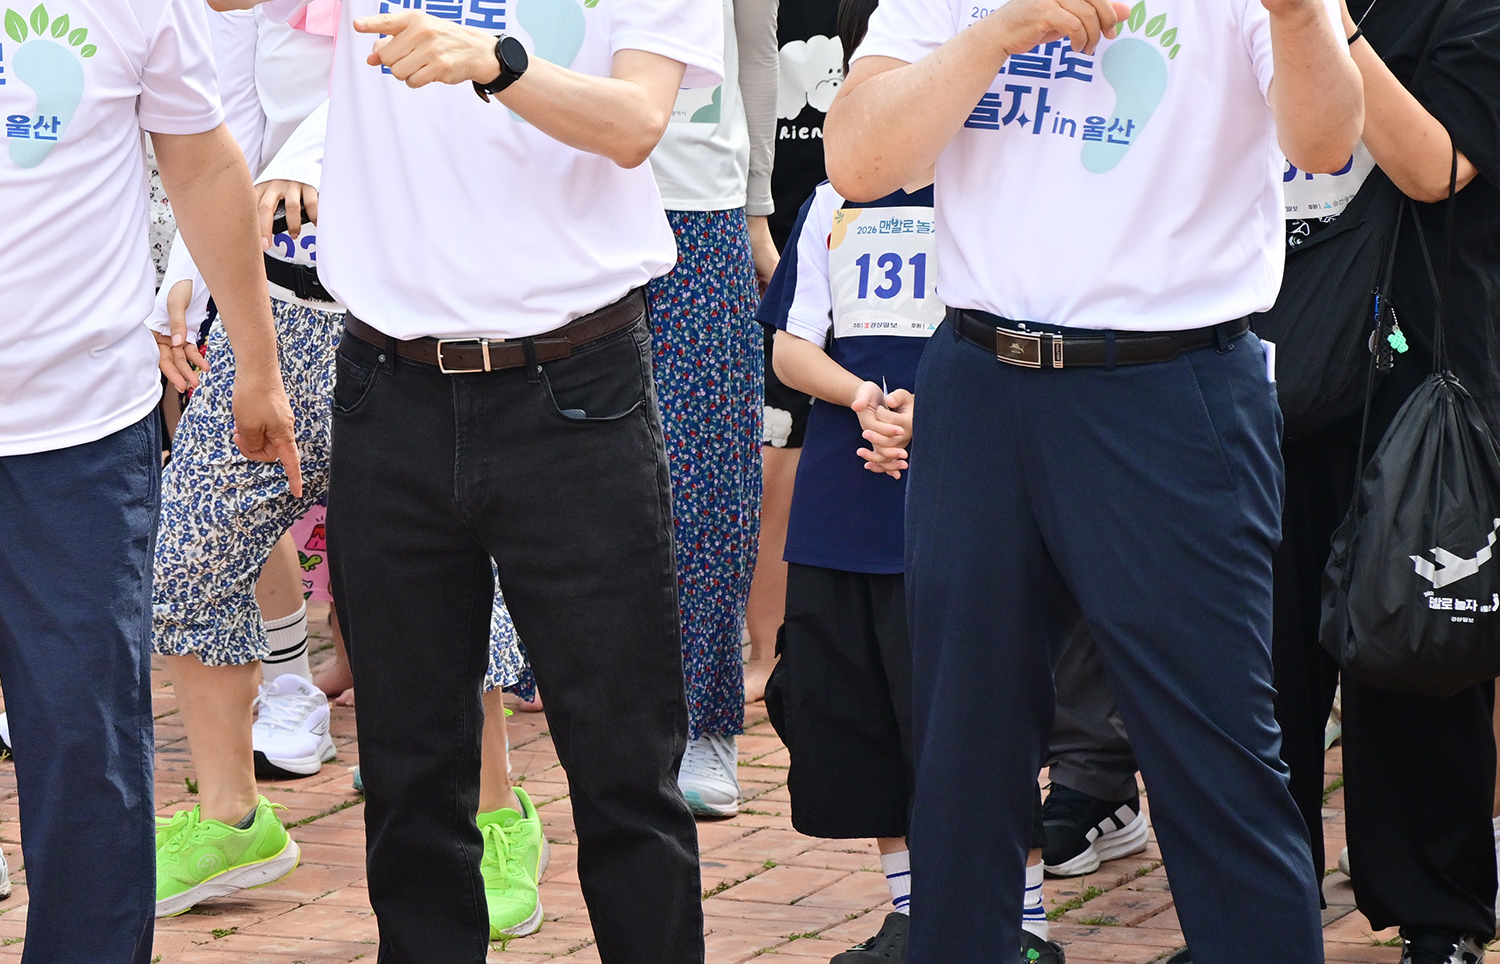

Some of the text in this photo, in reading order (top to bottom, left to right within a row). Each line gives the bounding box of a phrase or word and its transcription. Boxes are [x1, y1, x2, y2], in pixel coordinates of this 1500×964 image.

[971, 6, 995, 18] 20
[999, 35, 1096, 83] 발로
[5, 114, 61, 141] 울산
[1052, 111, 1077, 138] in
[1082, 115, 1136, 145] 울산
[857, 226, 878, 235] 2026
[879, 218, 914, 234] 맨발로
[855, 252, 937, 299] 131
